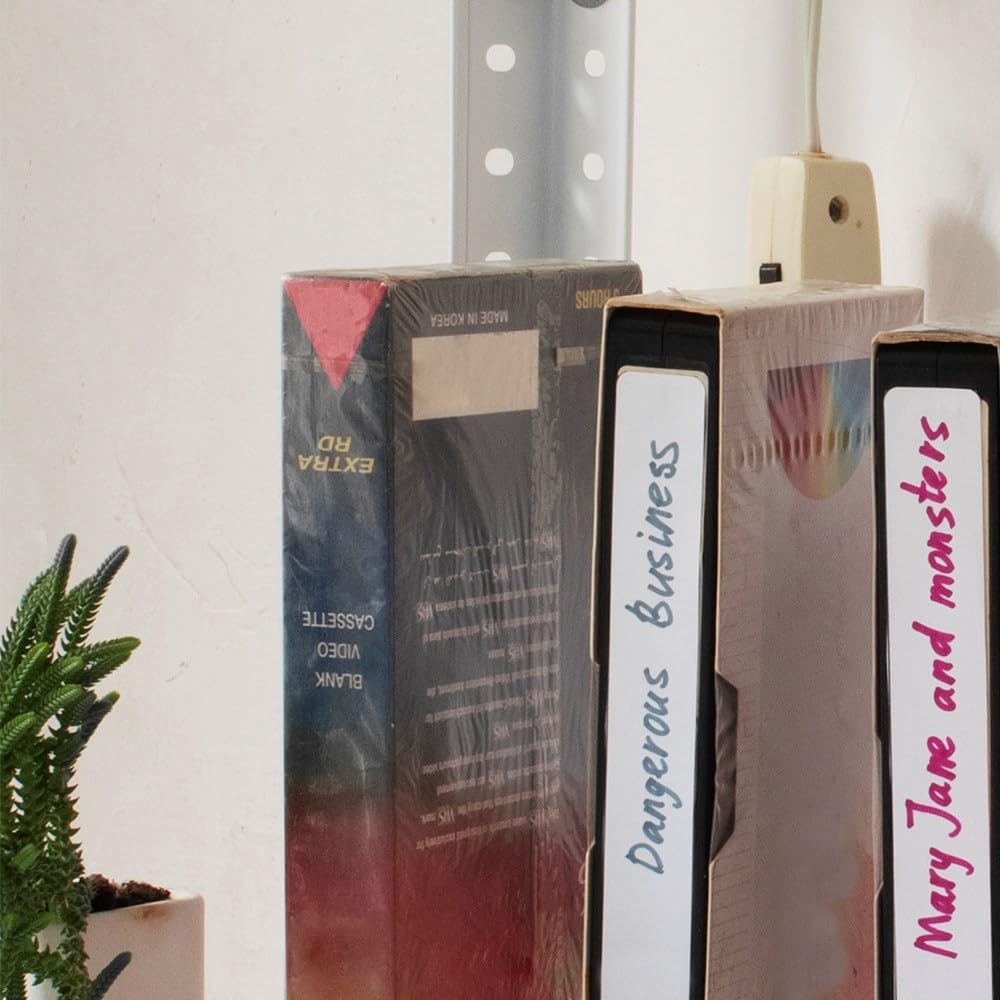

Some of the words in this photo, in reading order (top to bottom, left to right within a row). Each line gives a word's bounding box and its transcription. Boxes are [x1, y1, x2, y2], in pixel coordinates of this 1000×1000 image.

[430, 311, 465, 328] KOREA
[467, 311, 479, 325] IN
[480, 309, 509, 325] MADE
[317, 434, 351, 452] RD
[297, 453, 375, 475] EXTRA
[900, 416, 955, 609] monsters
[624, 439, 680, 628] Business
[302, 610, 375, 632] CASSETTE
[317, 641, 361, 660] VIDEO
[912, 621, 956, 712] and
[315, 670, 363, 691] BLANK
[624, 666, 682, 875] Dangerous
[905, 736, 962, 839] Jane
[914, 847, 974, 959] Mary
